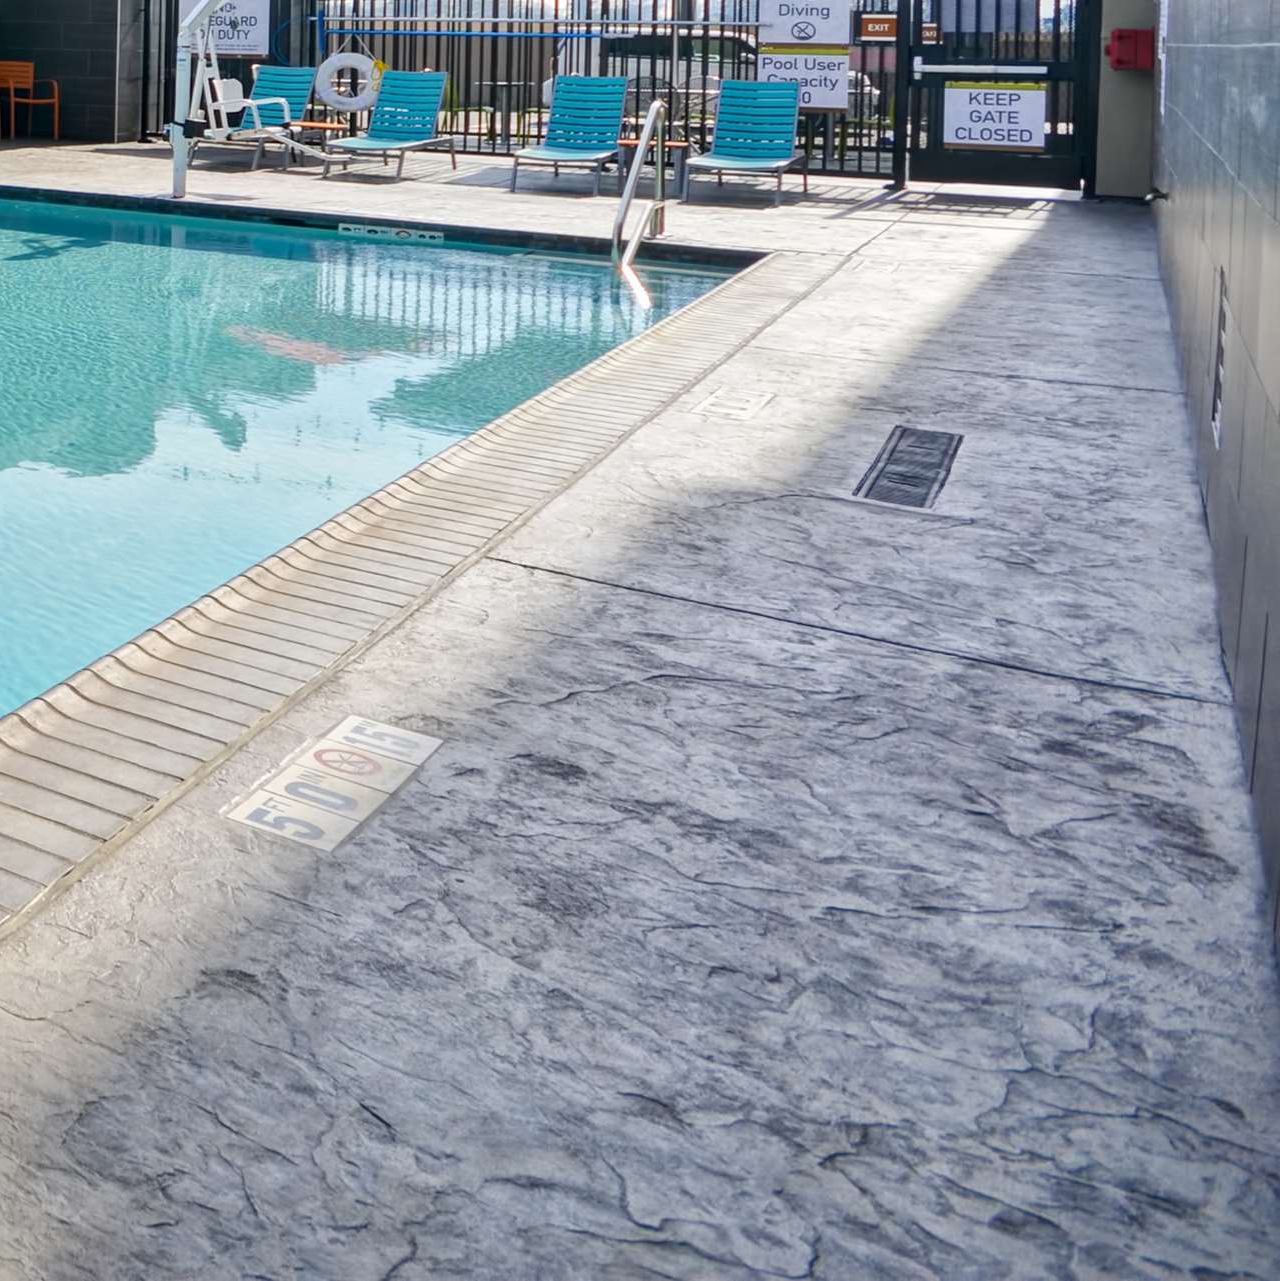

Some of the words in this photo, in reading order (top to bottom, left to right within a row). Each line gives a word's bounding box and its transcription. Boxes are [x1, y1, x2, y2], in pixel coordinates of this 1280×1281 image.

[779, 4, 830, 19] Diving
[218, 29, 250, 40] DUTY
[867, 23, 889, 32] EXIT
[762, 57, 798, 70] Pool
[804, 58, 845, 71] User
[767, 74, 839, 91] Cacity
[969, 92, 1021, 106] KEEP
[969, 110, 1019, 124] GATE
[955, 127, 1033, 142] CLOSED
[284, 782, 358, 811] 0
[245, 807, 325, 840] 5
